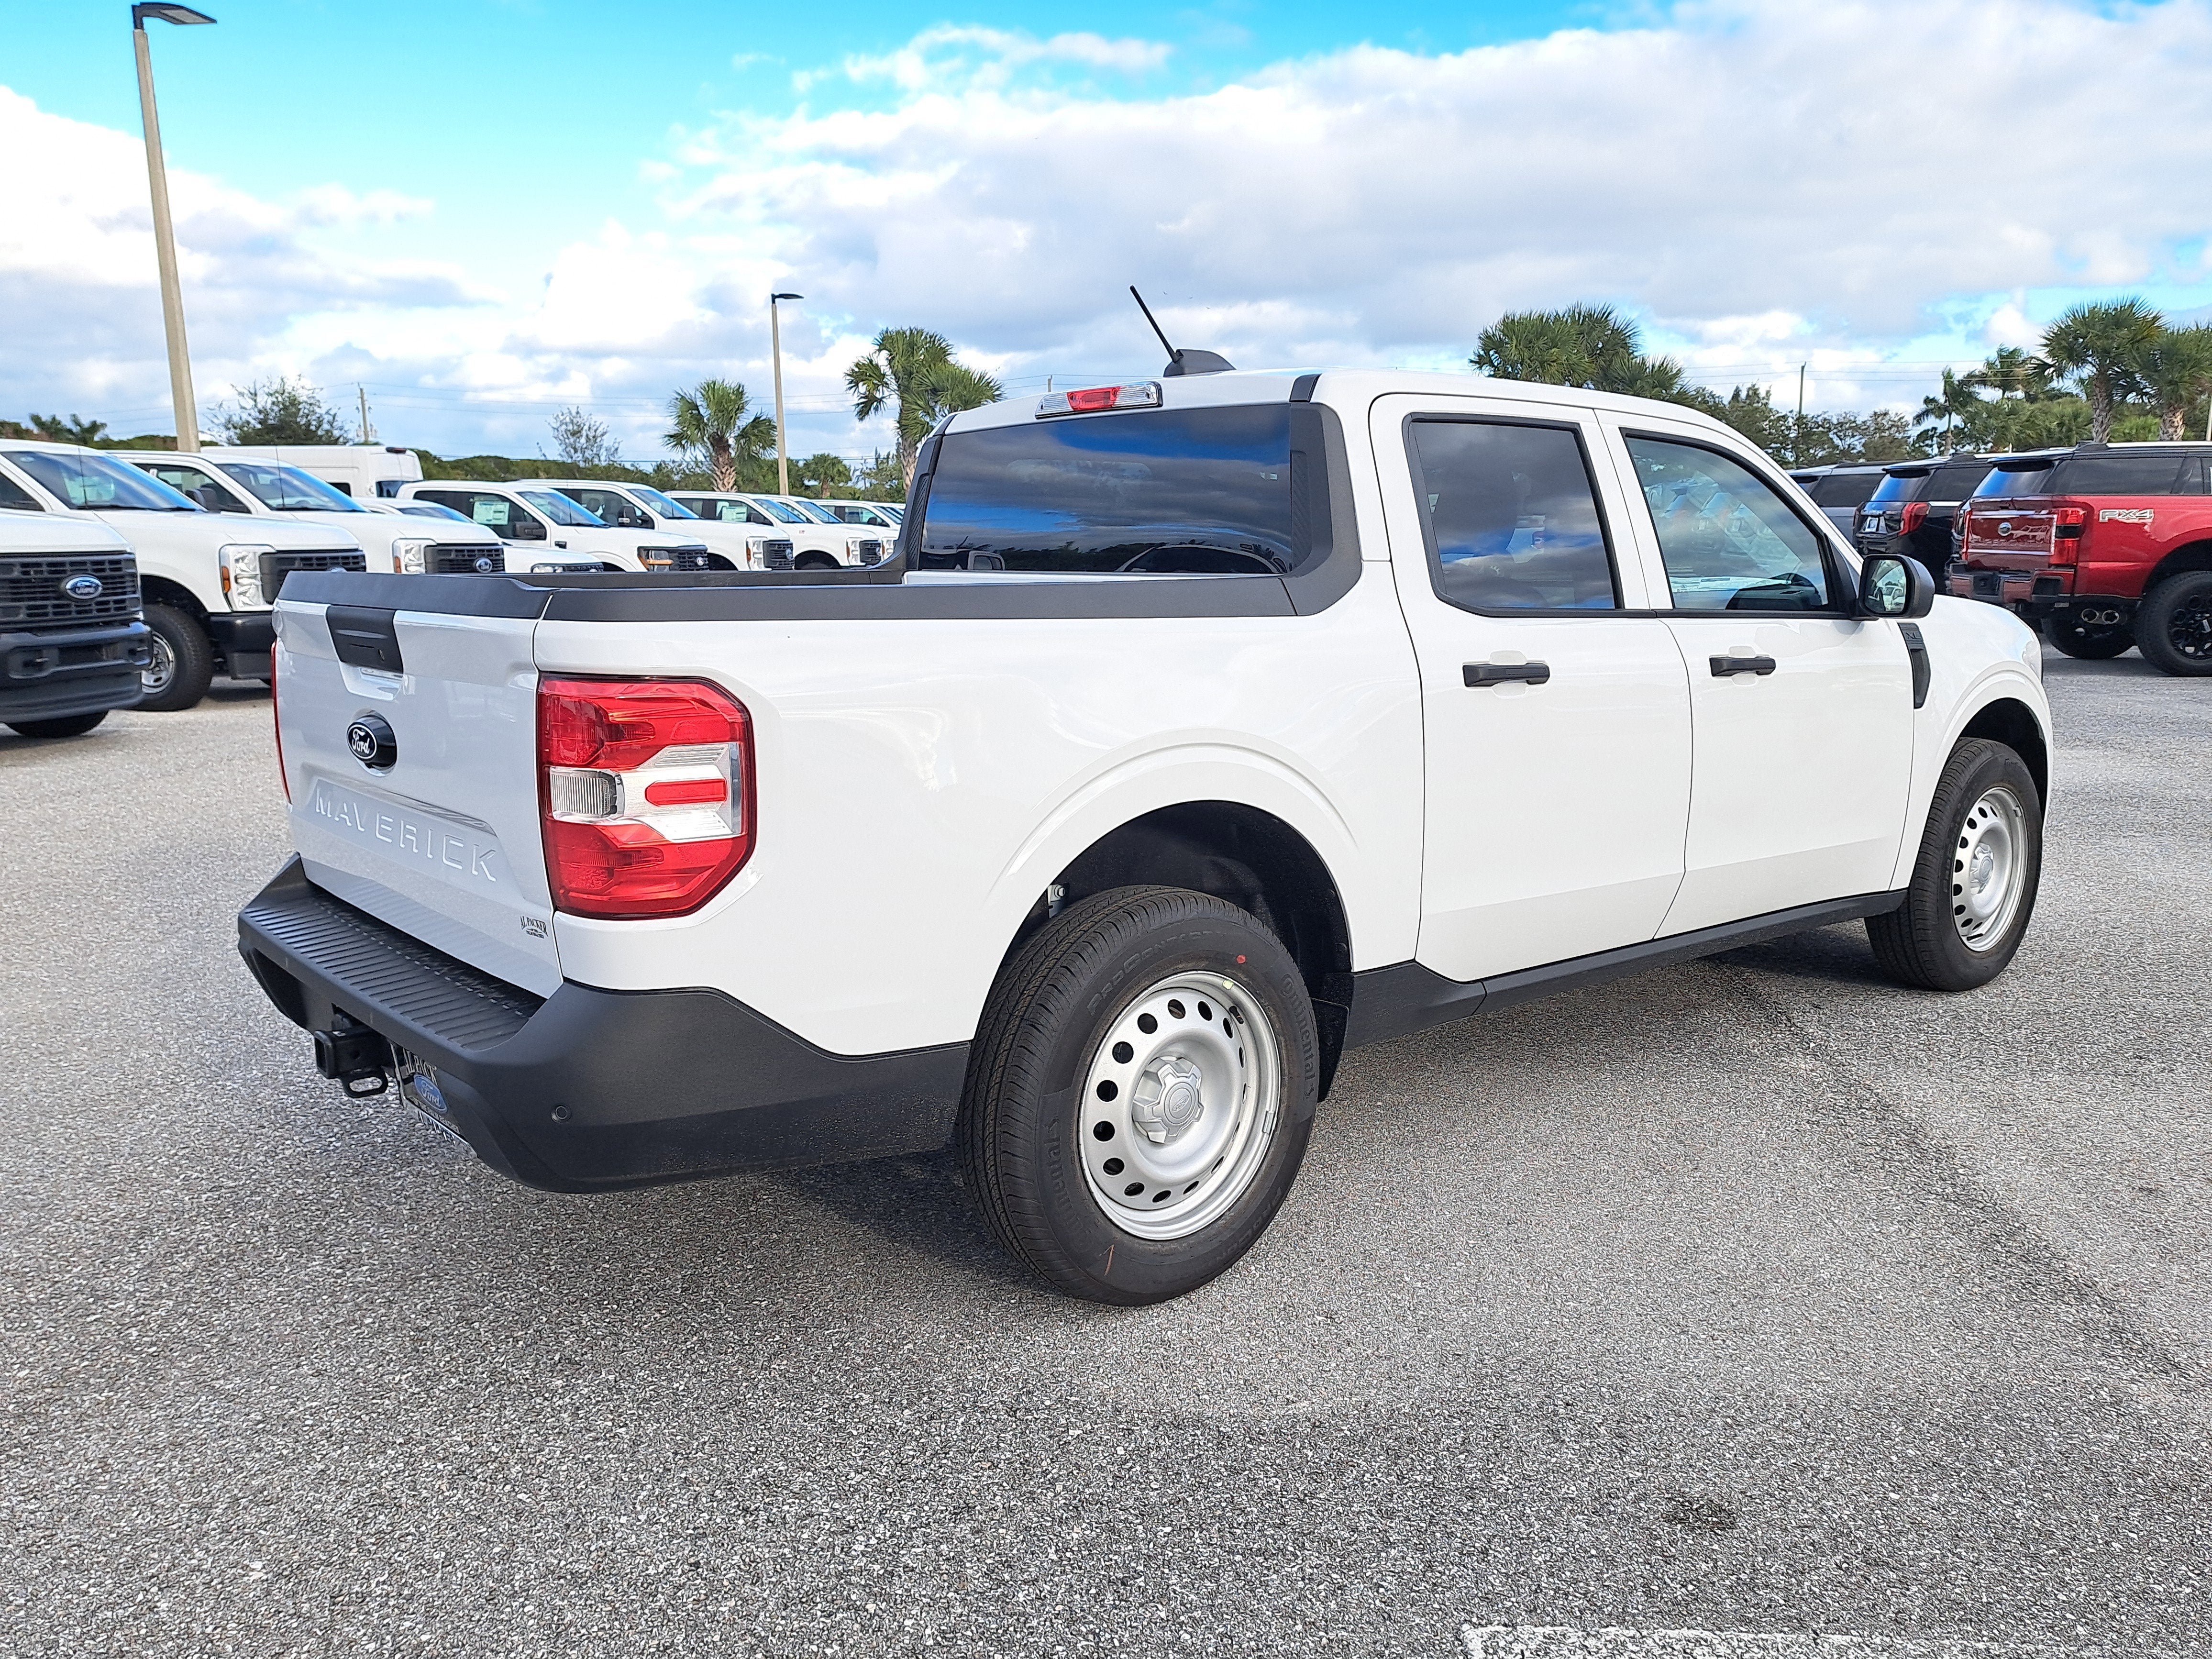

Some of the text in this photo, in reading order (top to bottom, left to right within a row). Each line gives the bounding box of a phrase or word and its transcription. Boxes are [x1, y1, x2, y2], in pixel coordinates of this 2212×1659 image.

[2098, 509, 2153, 522] FX4
[352, 728, 371, 754] Ford
[316, 788, 497, 882] MAVERICK
[526, 917, 549, 937] PACKER
[421, 1080, 441, 1108] Ford
